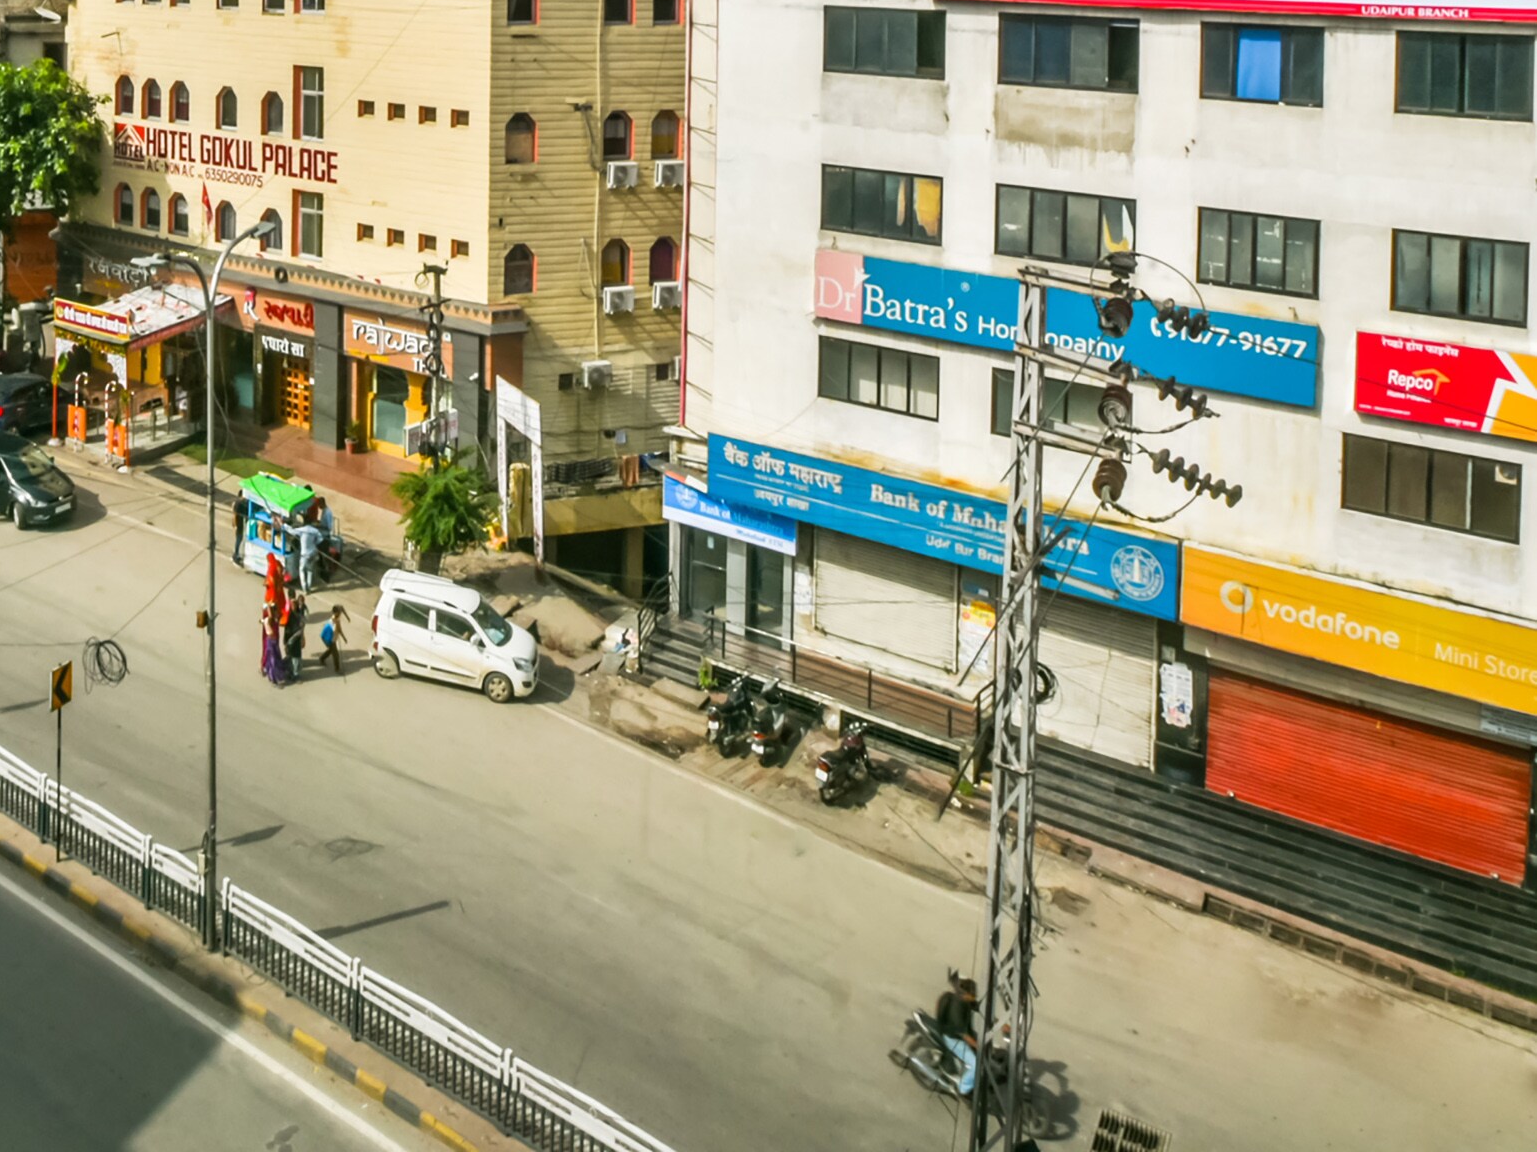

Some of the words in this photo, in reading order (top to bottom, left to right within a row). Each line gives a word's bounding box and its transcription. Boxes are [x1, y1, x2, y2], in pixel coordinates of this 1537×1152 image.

[1361, 6, 1416, 17] UDAIPUR
[1417, 8, 1469, 19] BRANCH
[146, 127, 196, 162] HOTEL
[200, 134, 258, 173] GOKUL
[262, 141, 338, 184] PALACE
[818, 276, 855, 313] Dr
[863, 283, 969, 333] Batra's
[351, 317, 438, 356] rajwad
[1388, 368, 1434, 391] Repco
[723, 441, 749, 467] बैंक
[752, 450, 786, 476] ऑफ
[788, 461, 843, 495] महाराष्ट्र
[699, 500, 720, 518] Bank
[870, 482, 920, 513] Bank
[926, 500, 949, 519] of
[1262, 598, 1401, 650] vodafone
[1433, 642, 1479, 671] Mini
[1483, 654, 1537, 686] Store
